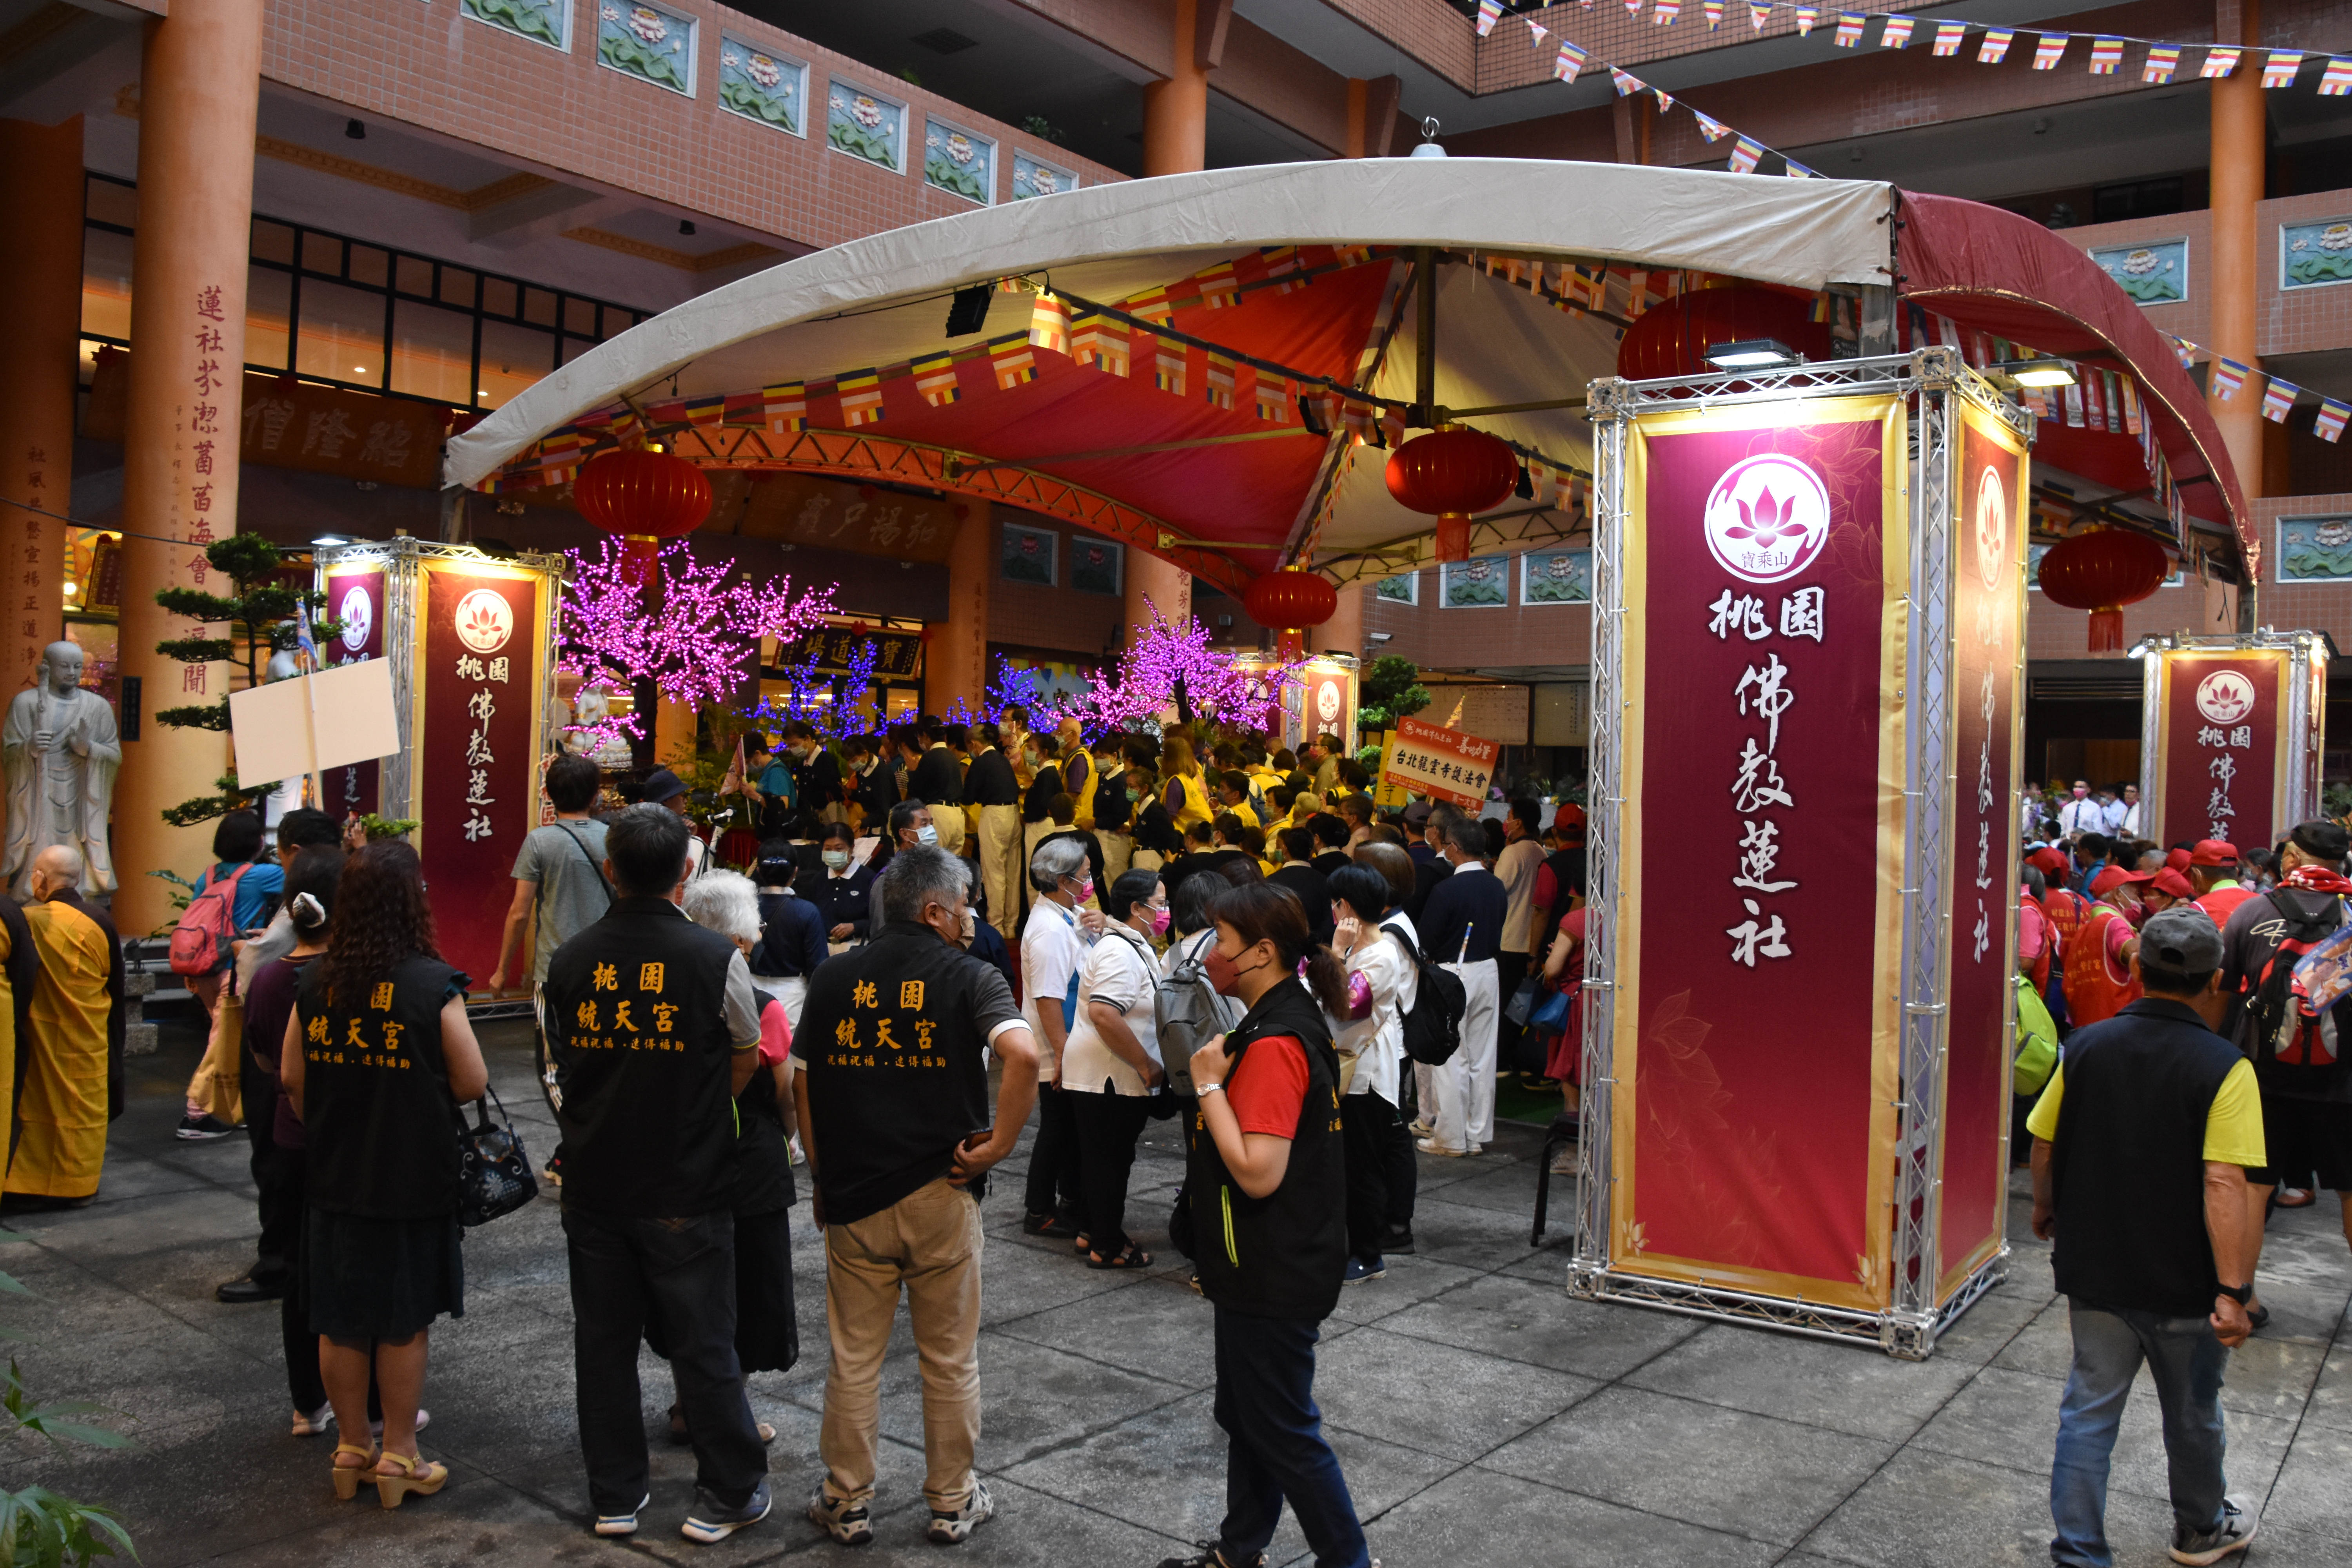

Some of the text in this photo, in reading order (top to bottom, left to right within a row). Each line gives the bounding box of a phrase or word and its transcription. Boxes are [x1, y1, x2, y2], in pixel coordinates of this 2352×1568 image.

[1742, 552, 1788, 569] 寶乘山
[1709, 586, 1824, 642] 桃園
[1976, 594, 2002, 650] 桃園
[457, 654, 509, 684] 桃園
[2198, 725, 2250, 749] 桃園
[463, 688, 496, 842] 佛教蓮社
[1397, 750, 1487, 789] 台北龍雲寺護法會
[1726, 653, 1798, 967] 佛教蓮社
[1973, 661, 1996, 963] 佛教蓮社
[592, 962, 664, 994] 桃園
[852, 979, 924, 1012] 桃園
[308, 1016, 405, 1050] 統天宮
[577, 1000, 679, 1033] 統天宮
[835, 1017, 937, 1050] 統天宮
